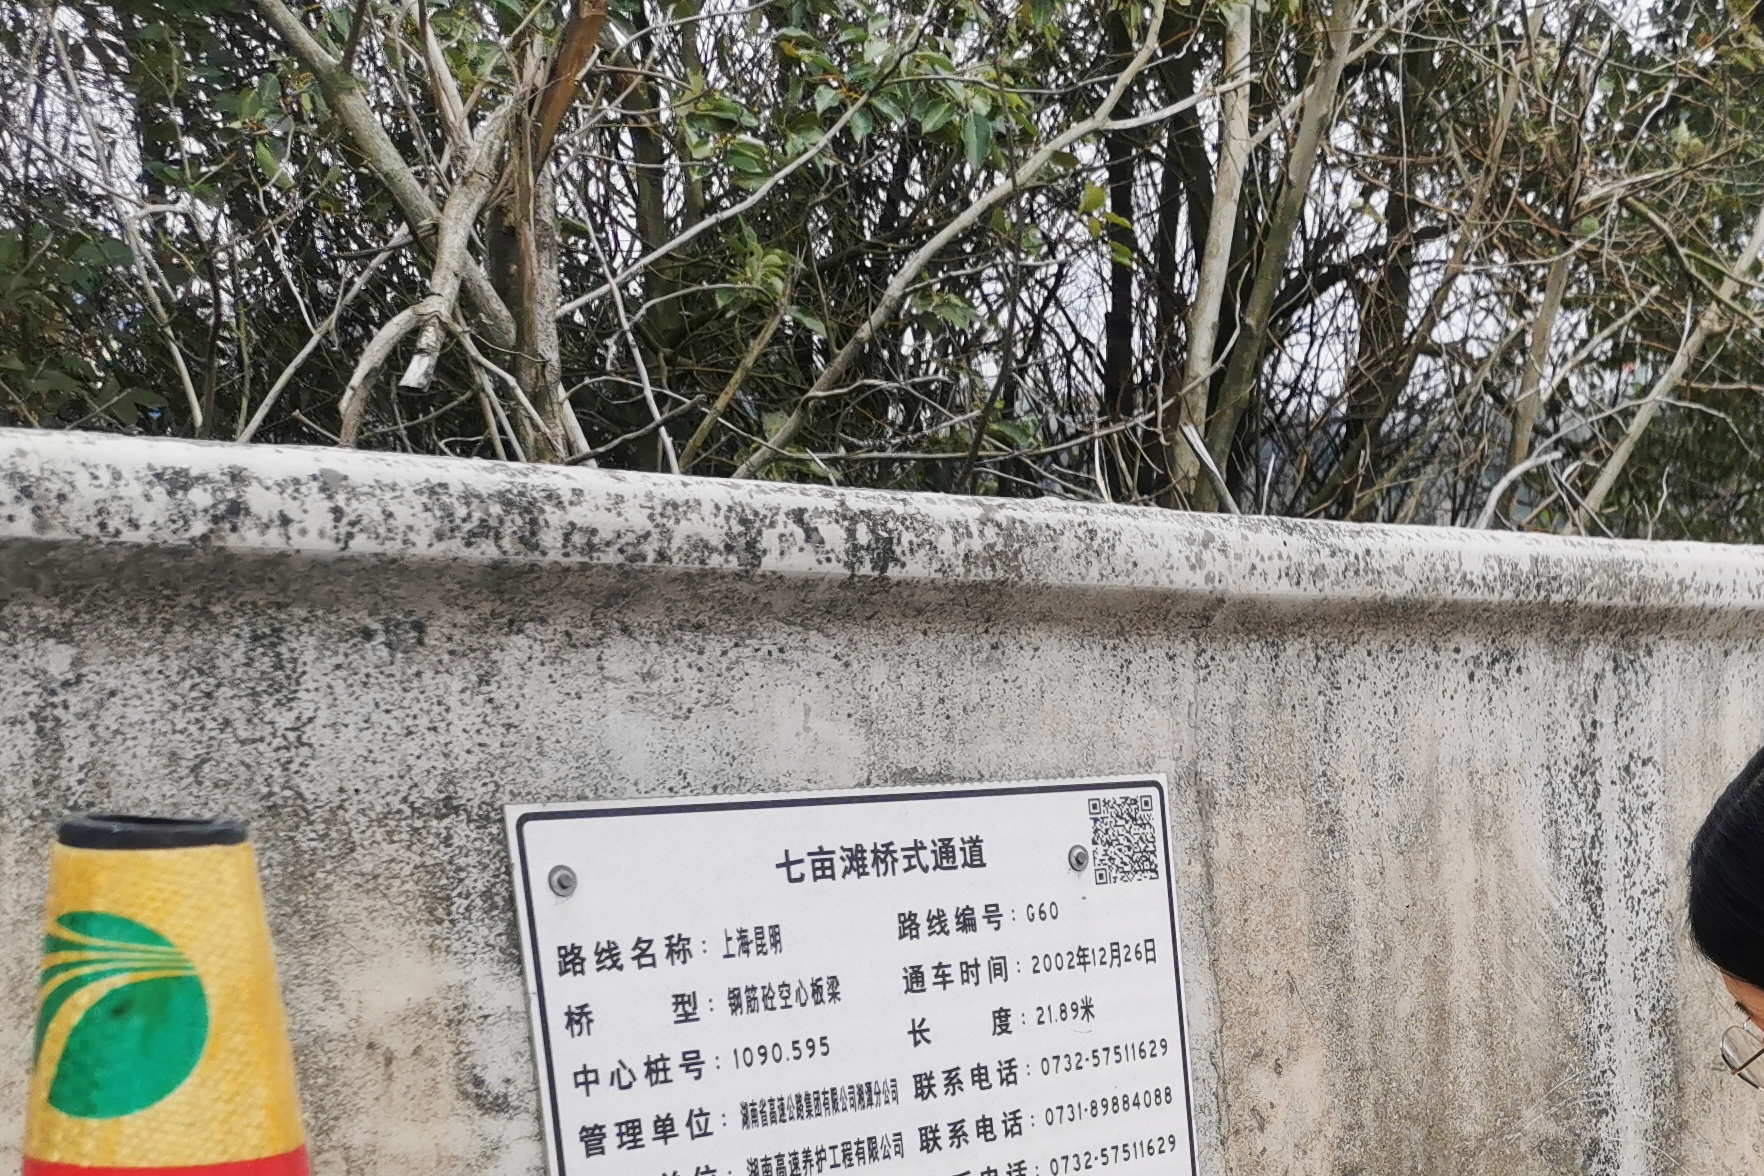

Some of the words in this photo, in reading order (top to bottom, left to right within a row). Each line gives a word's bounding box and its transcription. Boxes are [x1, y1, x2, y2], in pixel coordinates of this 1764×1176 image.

[775, 836, 988, 884] 七亩滩桥式通道
